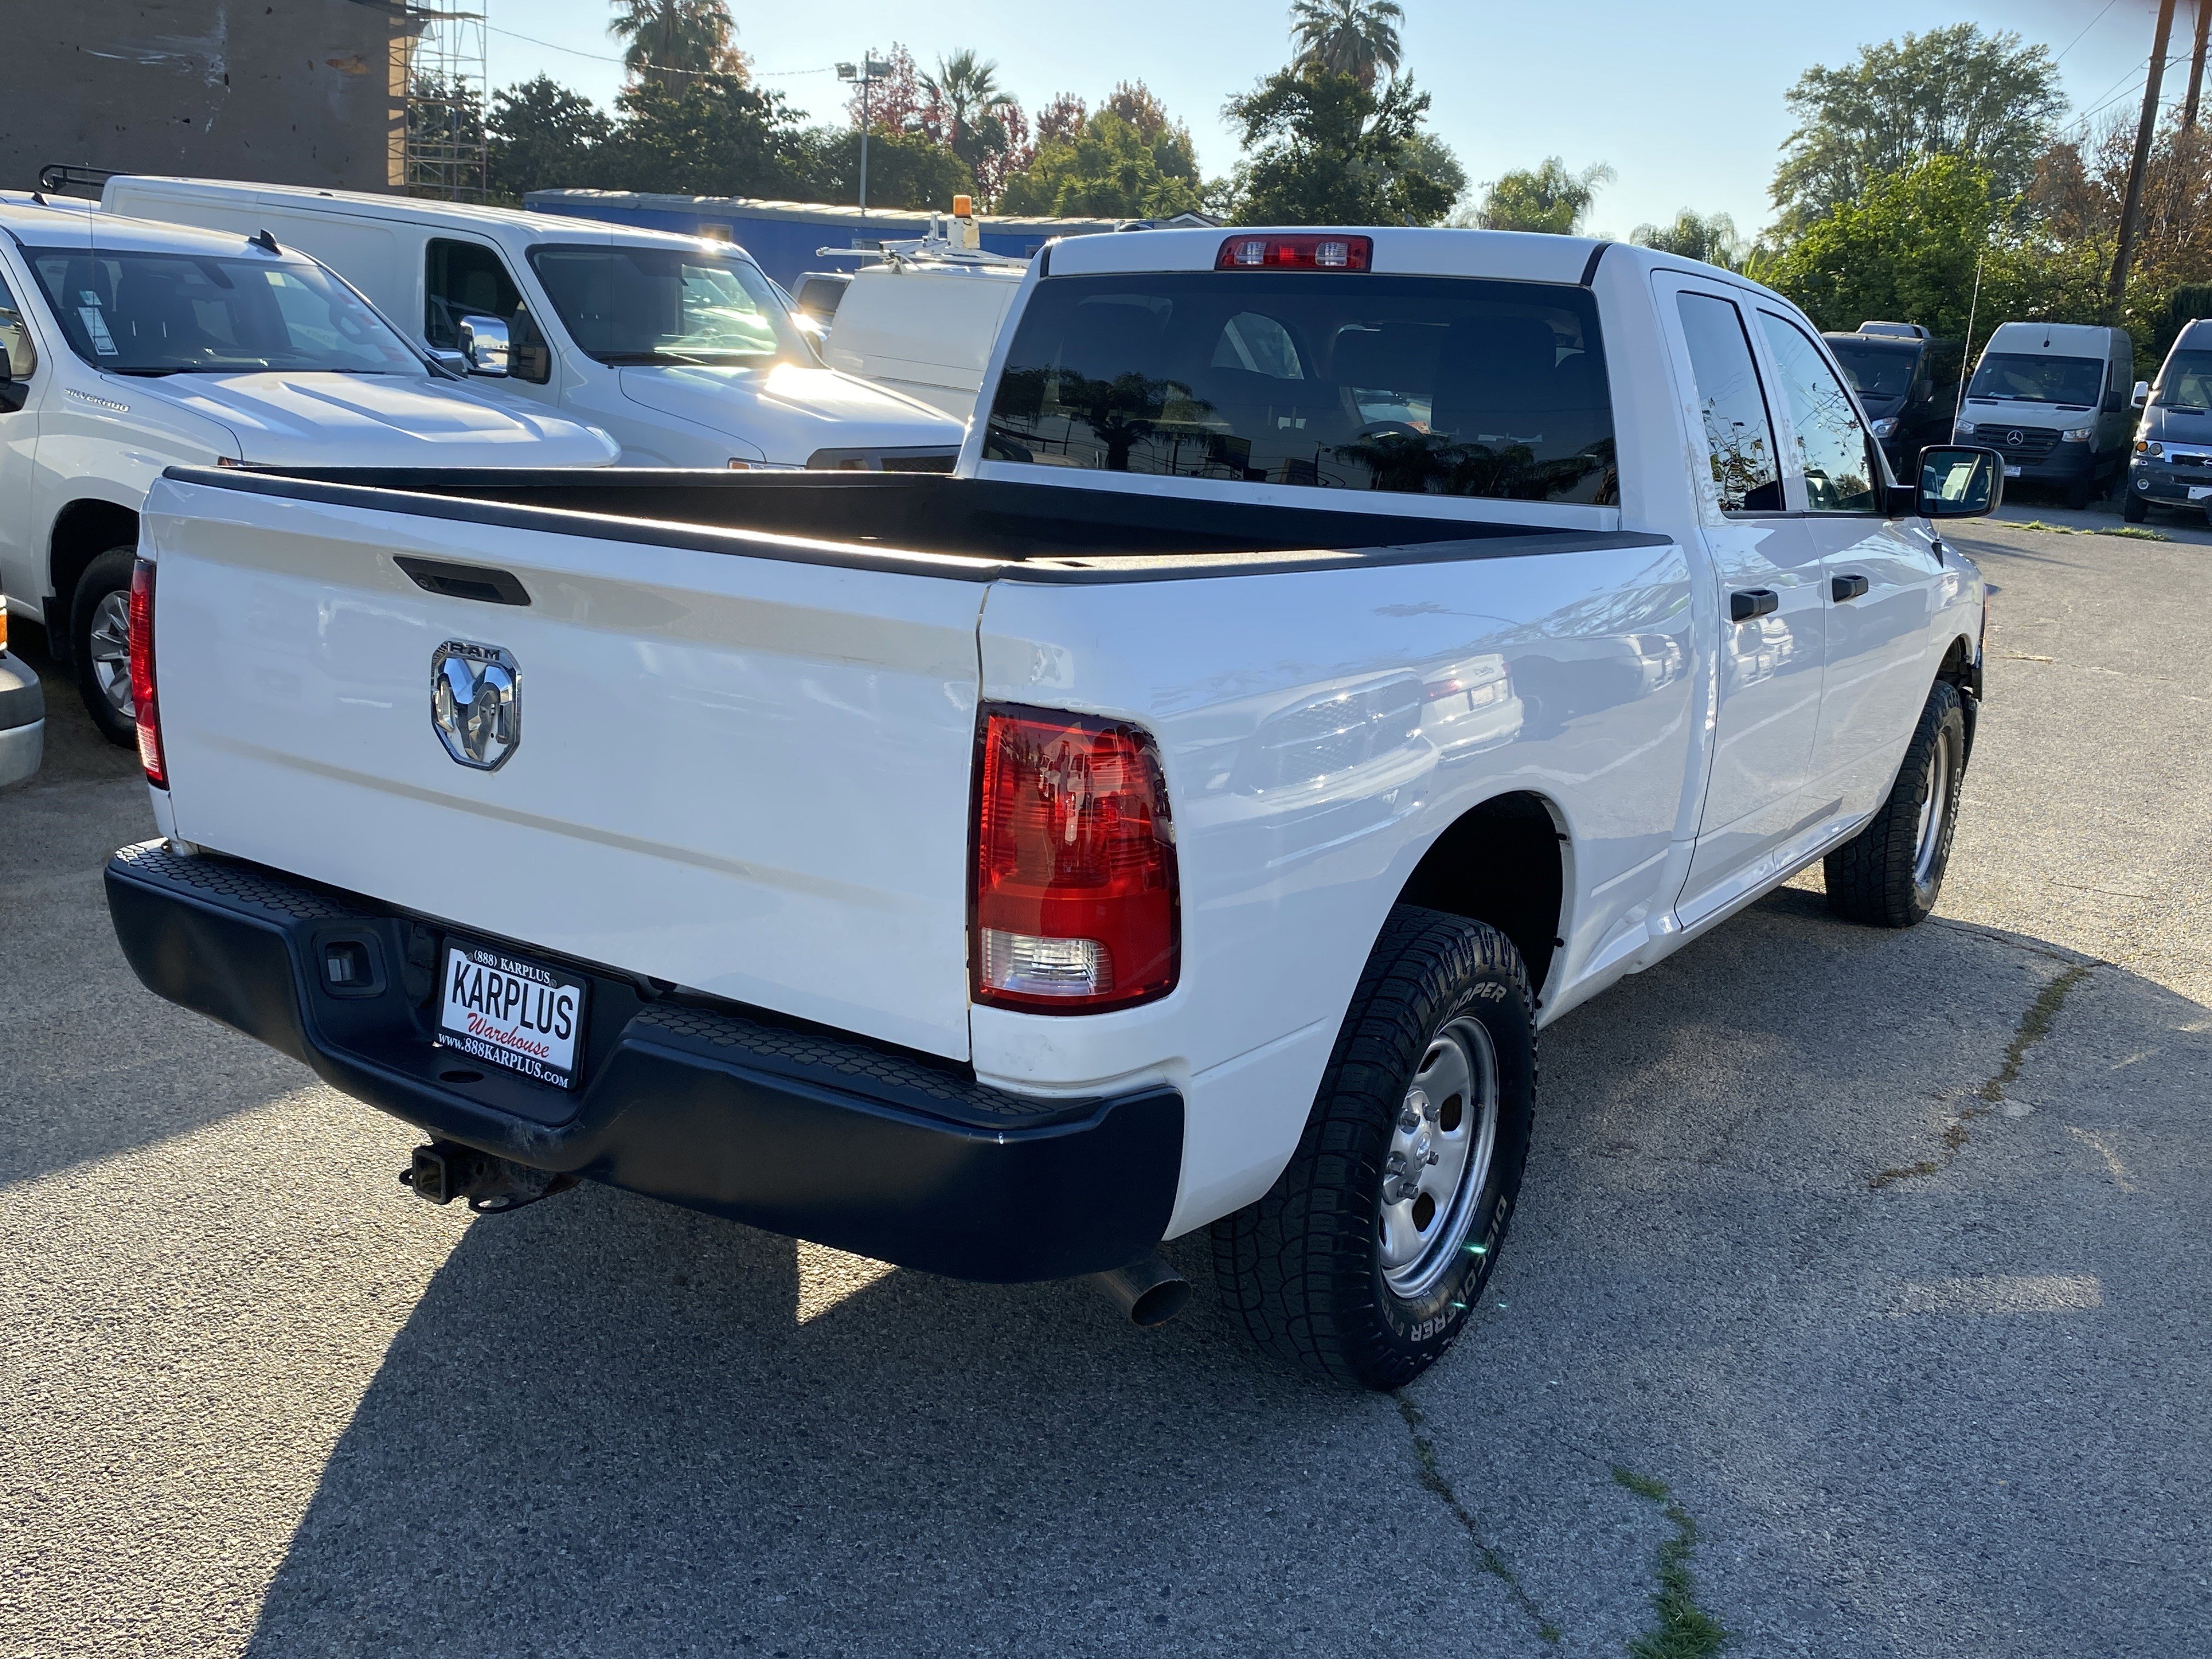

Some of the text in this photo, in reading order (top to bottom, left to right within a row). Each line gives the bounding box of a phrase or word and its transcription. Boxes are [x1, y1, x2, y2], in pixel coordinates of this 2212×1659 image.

[64, 387, 130, 412] SILVERADO
[447, 642, 500, 661] RAM
[1942, 768, 1962, 857] COOPER
[473, 950, 550, 984] (888) KARPLUS
[452, 961, 573, 1040] KARPLUS
[467, 1012, 550, 1058] Warehouse
[438, 1033, 569, 1088] www.888KARPLUS.COM
